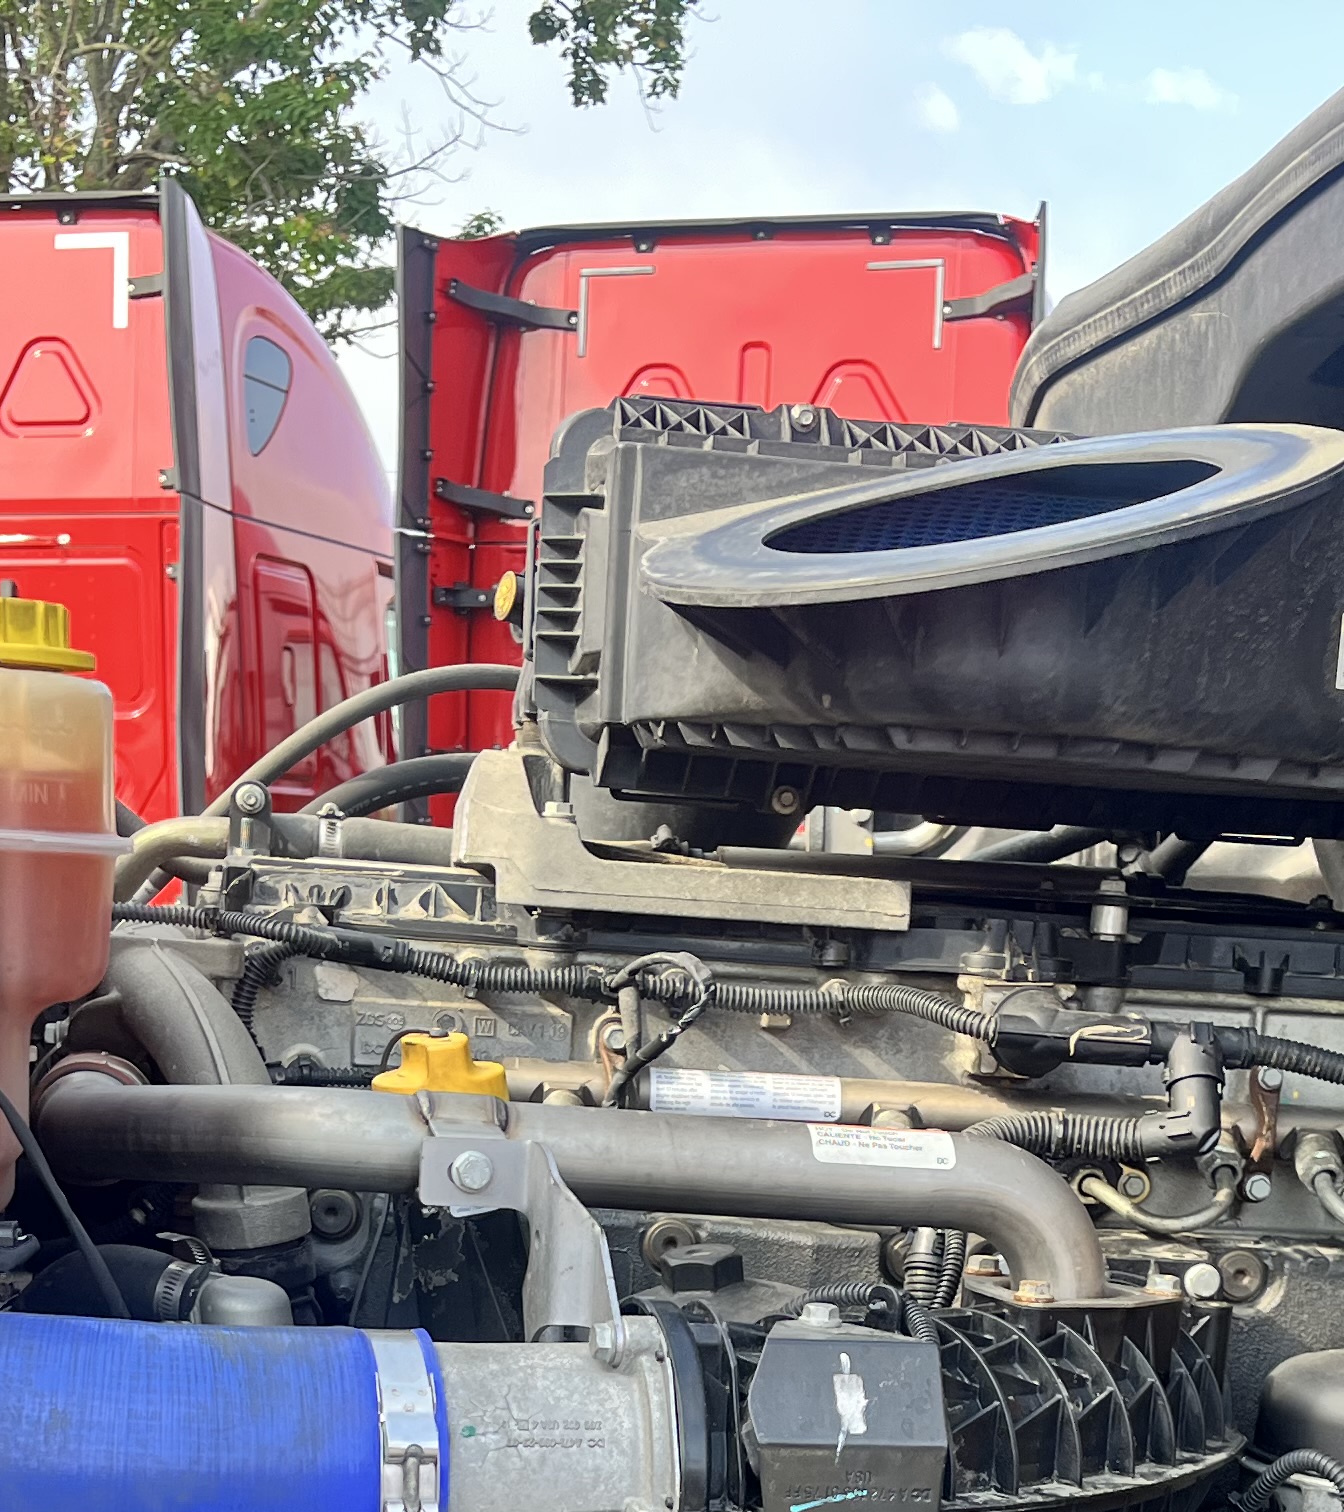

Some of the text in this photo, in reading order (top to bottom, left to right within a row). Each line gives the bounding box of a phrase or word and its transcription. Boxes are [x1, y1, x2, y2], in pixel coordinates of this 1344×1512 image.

[823, 1111, 836, 1119] DC
[817, 1132, 861, 1140] CALIENTE
[818, 1139, 851, 1147] CHAUD
